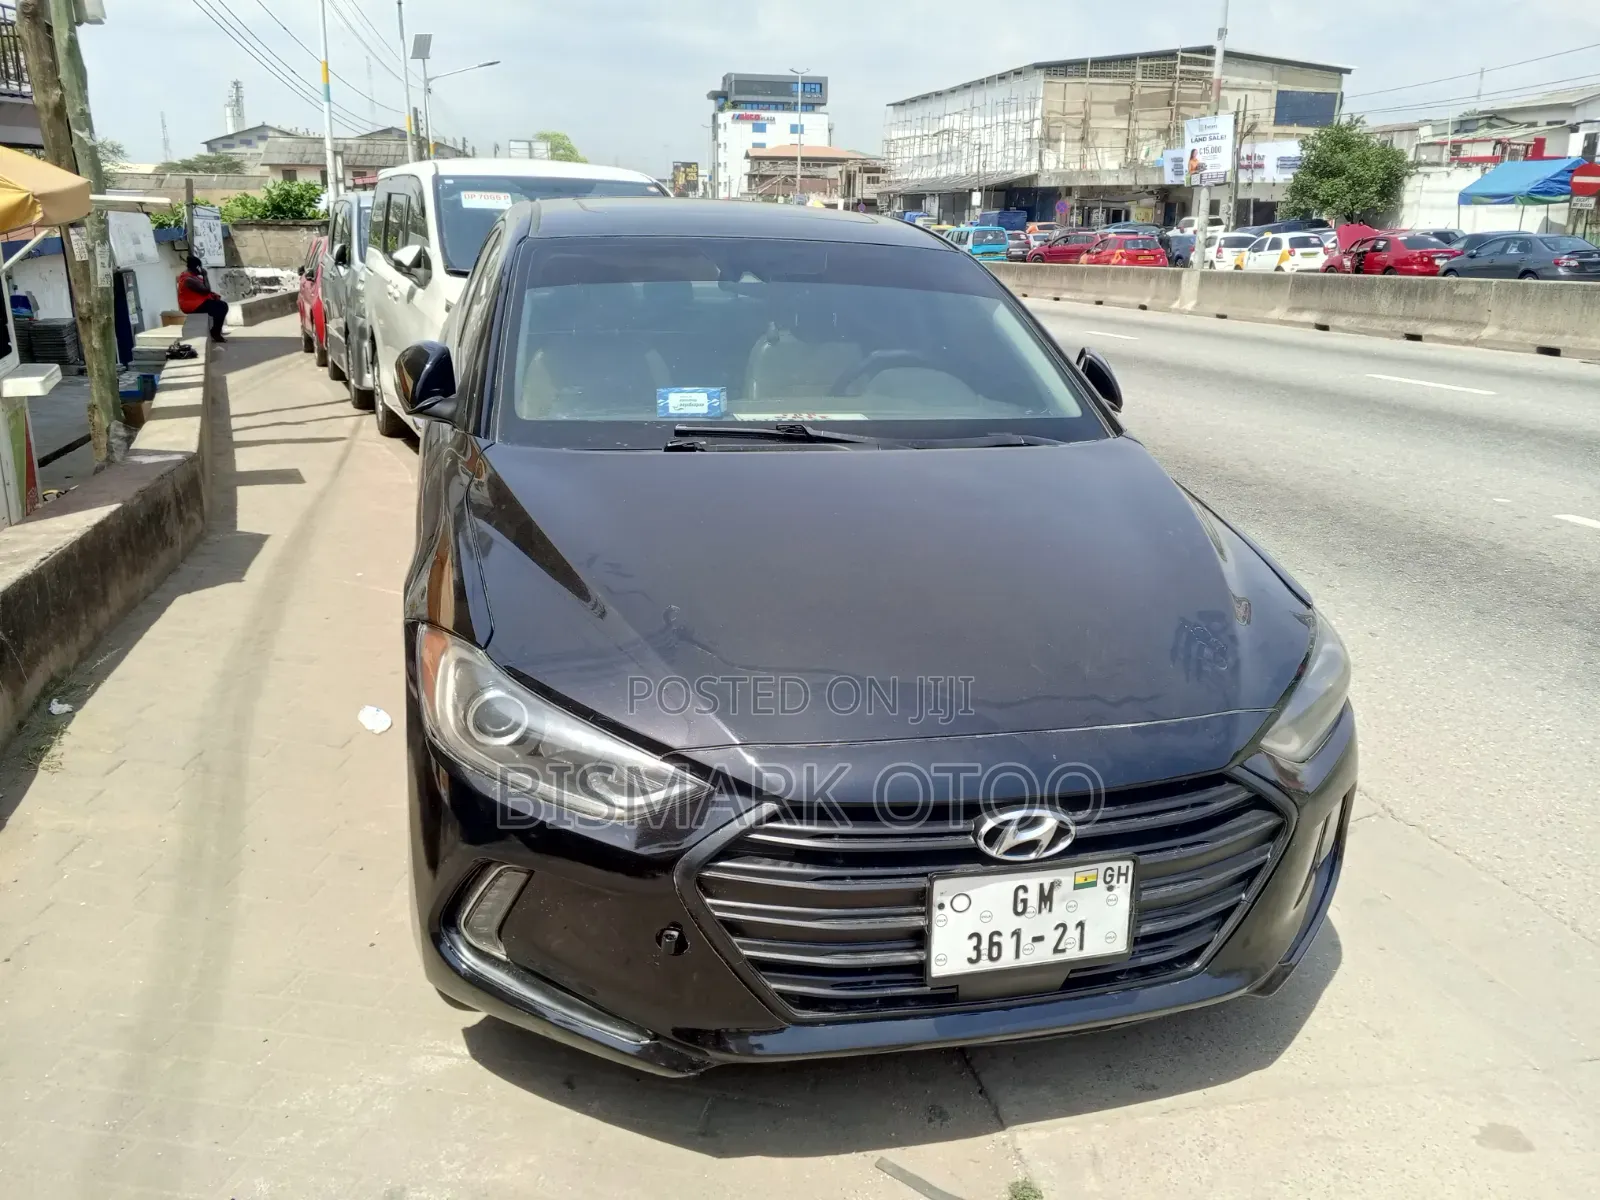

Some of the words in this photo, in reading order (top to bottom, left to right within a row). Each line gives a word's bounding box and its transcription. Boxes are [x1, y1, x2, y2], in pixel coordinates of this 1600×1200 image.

[1190, 136, 1207, 144] LAND
[1208, 134, 1227, 142] SALE!
[1103, 865, 1130, 885] GH
[966, 919, 1086, 965] 361-21
